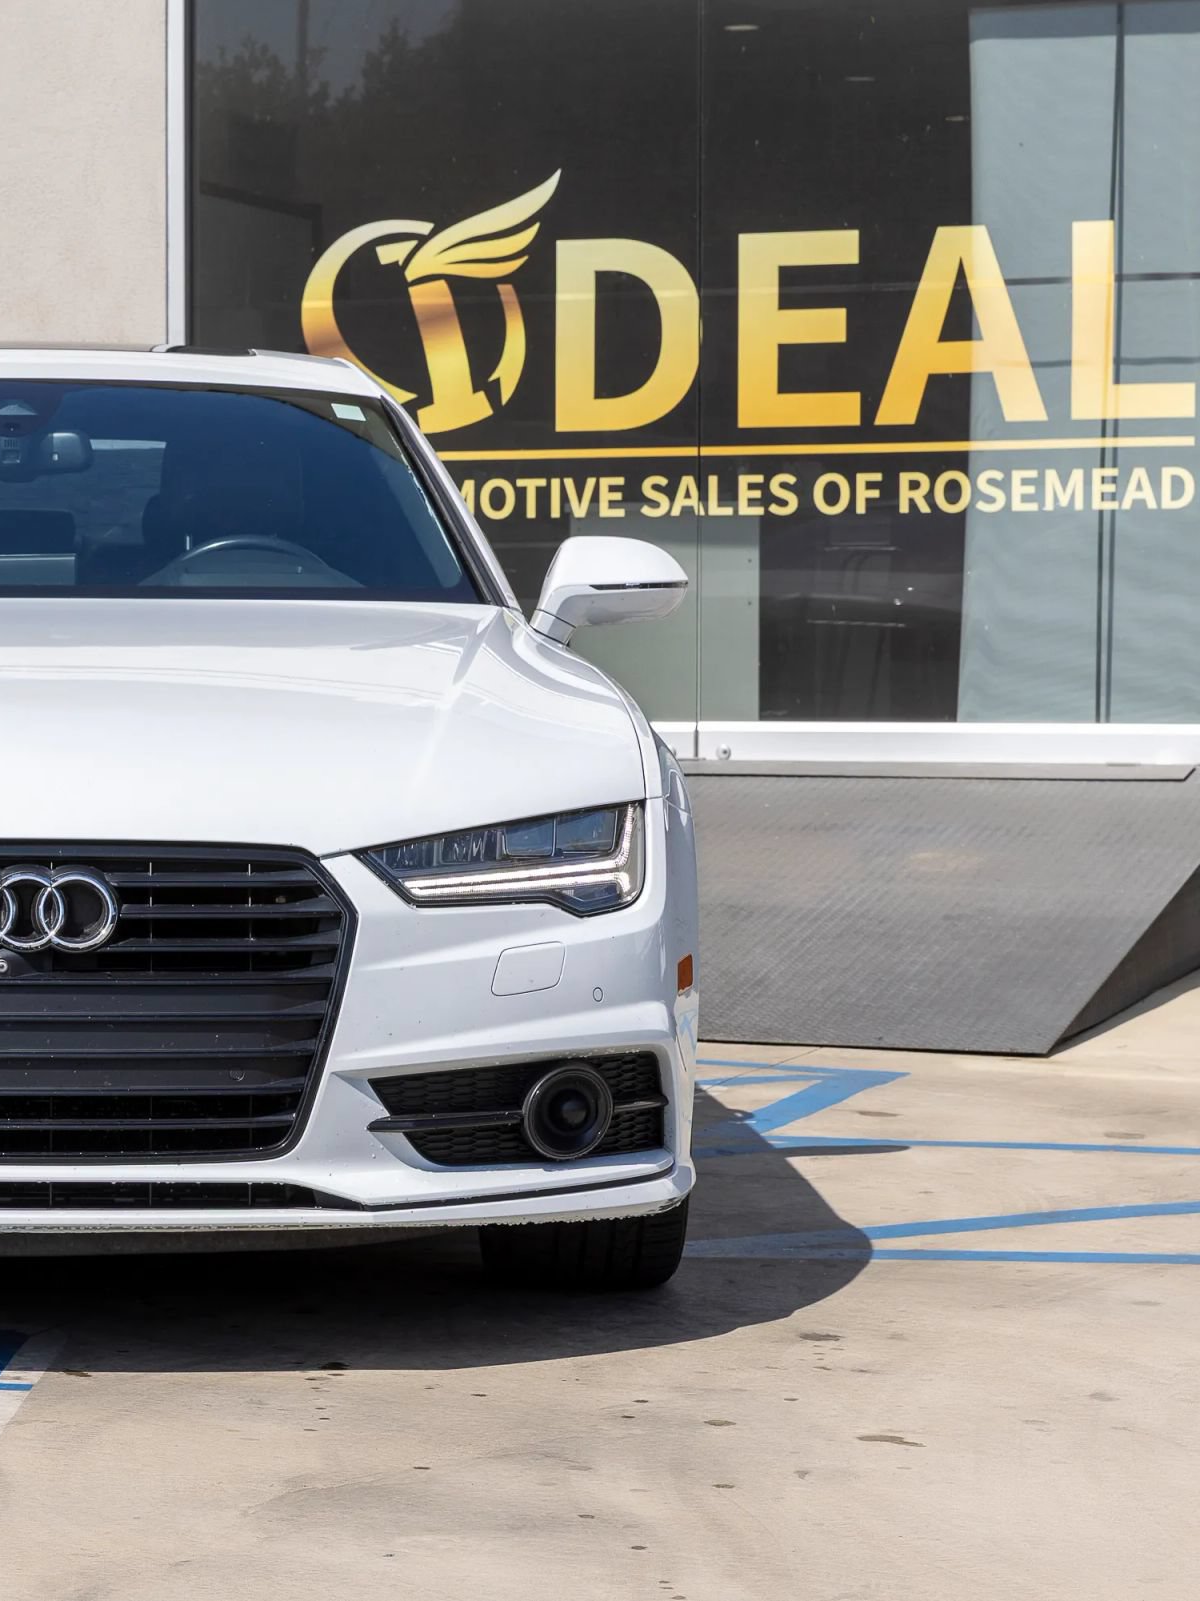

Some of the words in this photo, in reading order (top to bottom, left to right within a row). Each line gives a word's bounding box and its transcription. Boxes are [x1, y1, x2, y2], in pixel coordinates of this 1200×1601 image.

[640, 472, 800, 517] SALES
[812, 471, 884, 516] OF
[898, 466, 1196, 514] ROSEMEAD
